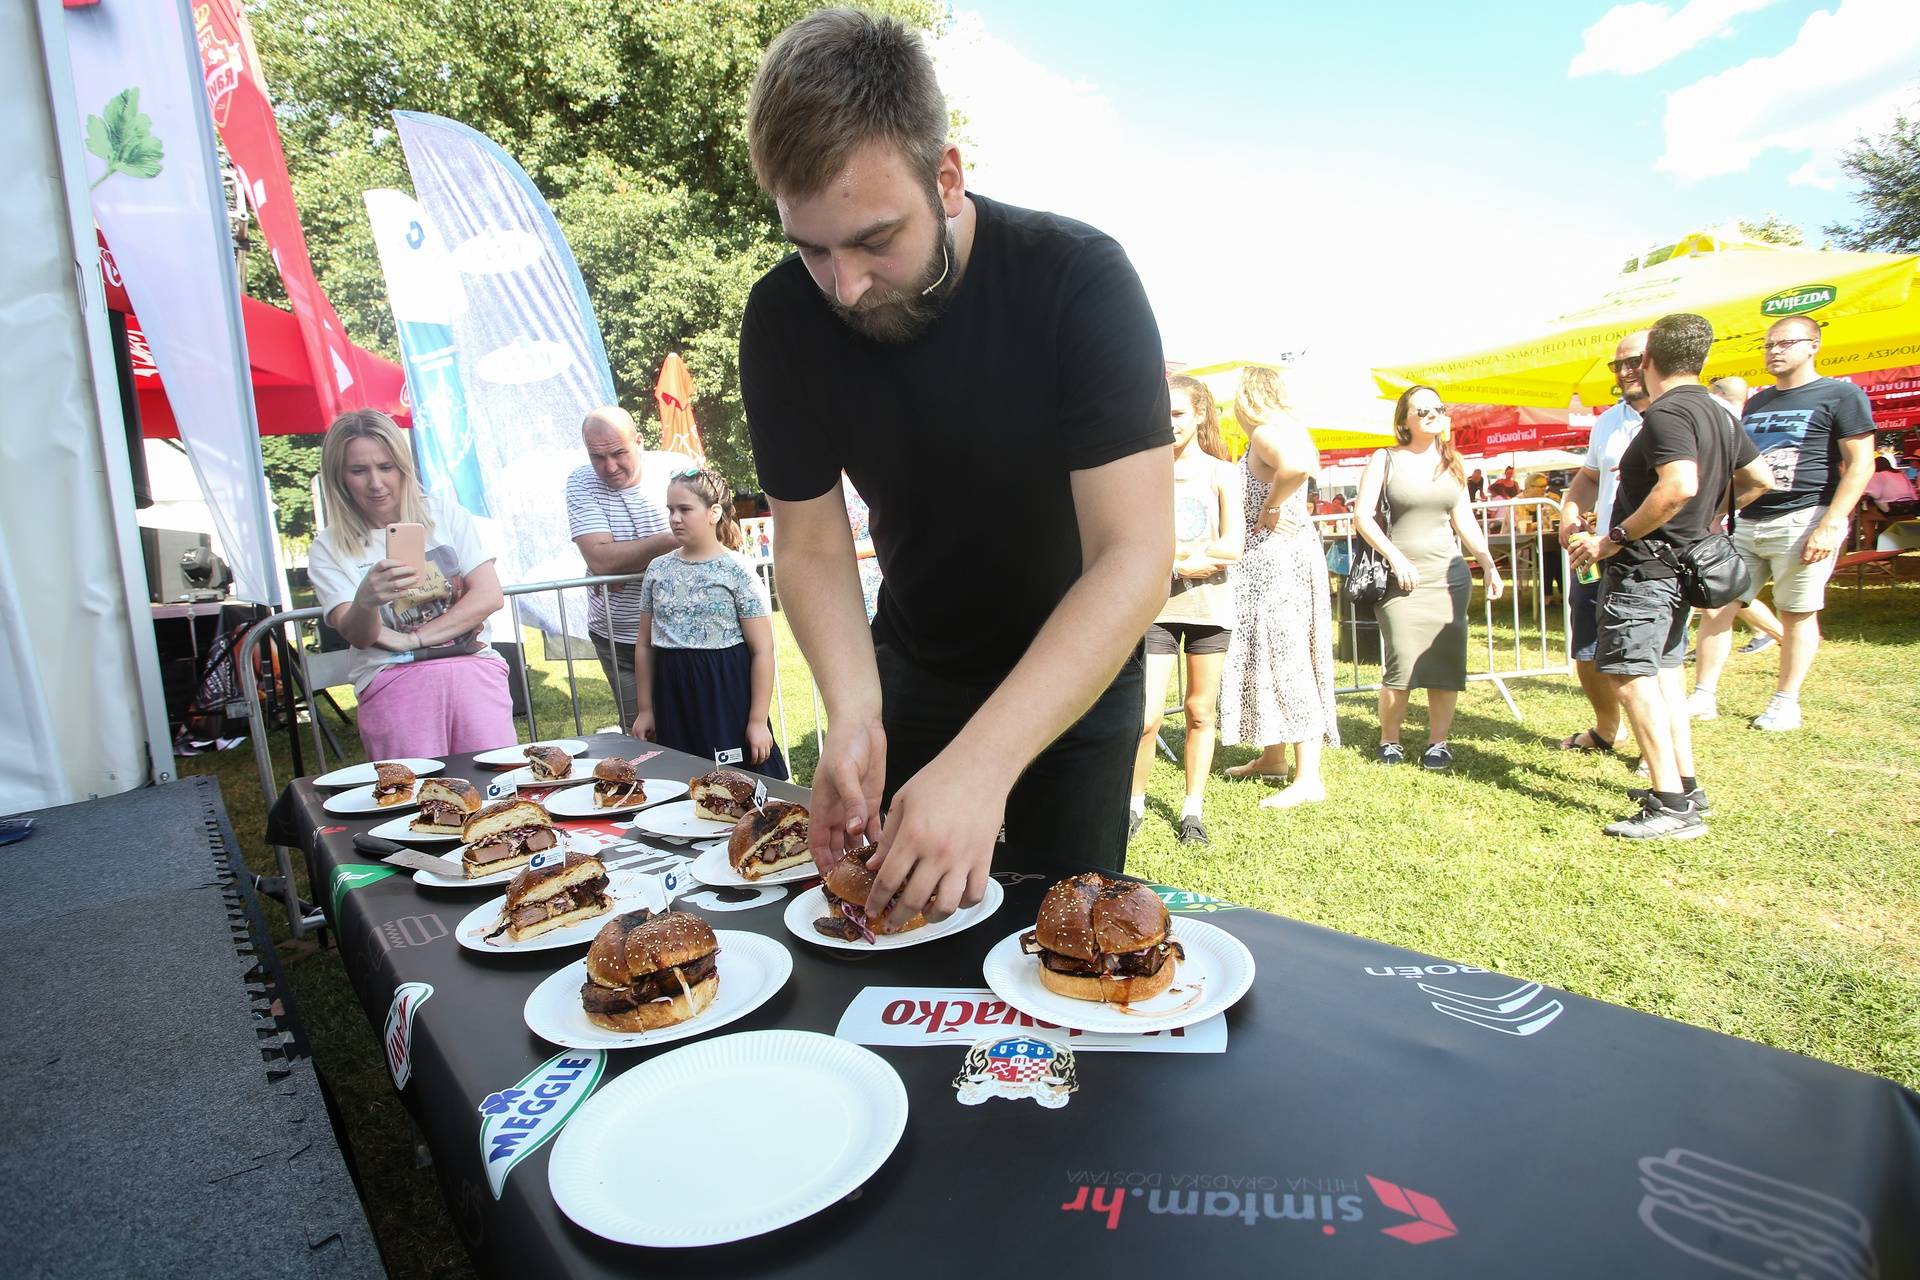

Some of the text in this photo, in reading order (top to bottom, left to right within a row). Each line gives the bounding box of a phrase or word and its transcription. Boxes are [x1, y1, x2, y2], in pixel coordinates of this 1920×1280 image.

[1766, 290, 1831, 311] ZVIJEZDA
[489, 1058, 592, 1163] MEGGLE
[1066, 1169, 1358, 1193] HITNA GRADSKA DOSTAVA
[1061, 1186, 1364, 1236] simtam.hr
